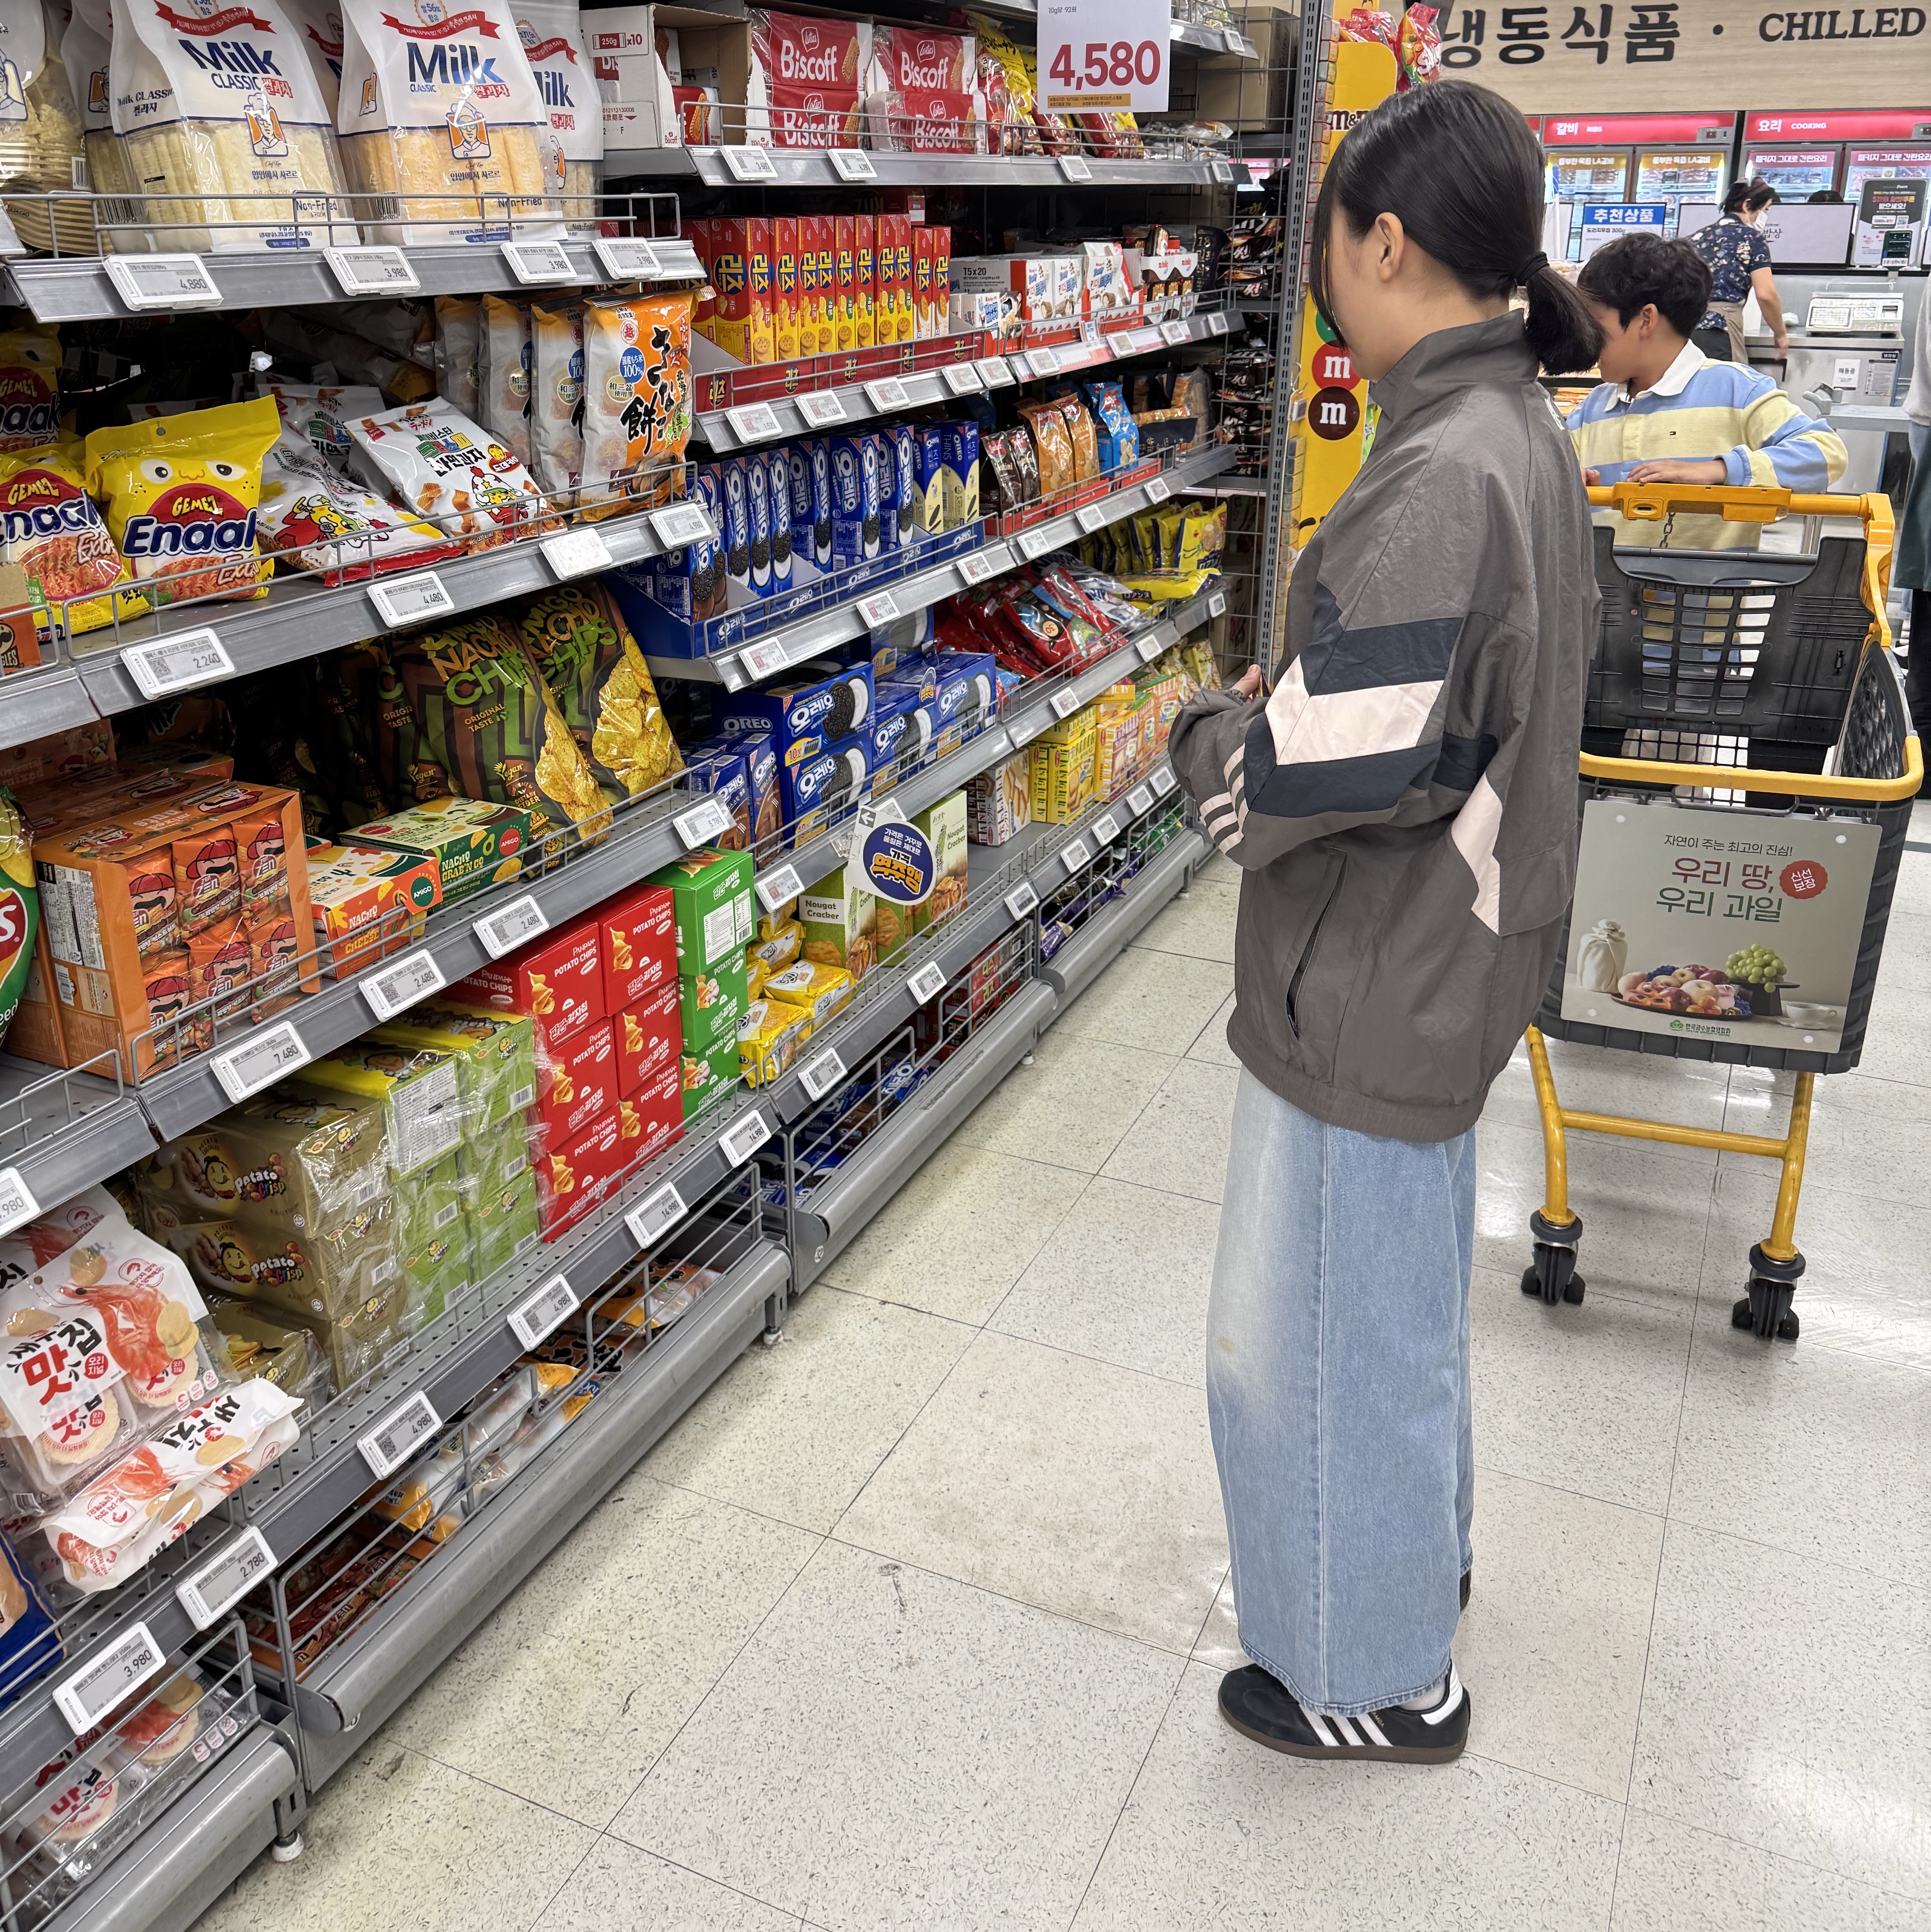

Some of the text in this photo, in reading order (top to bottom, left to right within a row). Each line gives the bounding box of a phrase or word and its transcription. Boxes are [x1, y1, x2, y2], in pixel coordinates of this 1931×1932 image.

[1758, 7, 1926, 42] CHILLED
[602, 33, 642, 46] 250g x10
[1442, 2, 1680, 69] 냉동식품
[178, 39, 282, 76] Milk
[407, 42, 506, 84] Milk
[781, 40, 838, 82] Biscoff
[1049, 40, 1161, 91] 4,580
[901, 51, 949, 90] Biscoff
[211, 73, 261, 91] CLASSIC
[410, 83, 510, 99] CLASSIC 쌀과자
[136, 87, 175, 102] CLASSIC
[133, 102, 158, 117] 쌀과자
[550, 113, 575, 130] 쌀과자
[783, 110, 840, 147] Biscoff
[1557, 123, 1578, 135] 갈비
[1758, 119, 1781, 133] 요리
[280, 170, 298, 179] 사르르
[482, 170, 501, 179] 사르르
[296, 200, 338, 211] Non-Fred
[1594, 209, 1654, 224] 추천상품
[384, 268, 408, 279] 3,980
[549, 260, 567, 270] 3,980
[180, 278, 207, 290] 4,880
[622, 356, 643, 366] 国産もち米
[1324, 356, 1350, 378] m
[623, 365, 644, 378] 100%
[559, 385, 580, 393] 和三盆
[609, 382, 633, 393] 和三盆
[1320, 402, 1347, 425] m
[913, 442, 922, 470] OREO
[943, 433, 952, 460] THINS
[953, 434, 961, 462] OREO
[814, 445, 831, 523] 오레오
[834, 447, 857, 512] 오레오
[864, 442, 881, 519] 오레오
[770, 454, 790, 537] 오레오
[171, 495, 223, 518] GEMEZ
[424, 592, 444, 603] 4,480
[193, 653, 220, 669] 2,240
[430, 629, 518, 682] NACHO
[388, 715, 413, 729] TASTE
[464, 702, 506, 727] ORIGINAL
[788, 693, 835, 737] 오레오
[468, 717, 495, 733] TASTE
[722, 717, 773, 732] OREO
[494, 762, 524, 781] Vegan
[797, 756, 837, 800] 오레오
[885, 827, 922, 849] 가격은 거꾸로
[946, 824, 965, 840] Nougat
[500, 836, 519, 848] AMIGO
[883, 835, 921, 856] 품질은 제대로
[947, 835, 966, 851] Cracker
[1664, 834, 1793, 857] 자연이 주는 최고의 진심!
[441, 851, 470, 871] NACHO
[890, 848, 911, 864] 가격
[442, 856, 484, 882] GRAB'N GO
[1671, 857, 1774, 894] 우리 땅,
[1790, 867, 1812, 883] 신선
[413, 885, 432, 899] AMIGO
[1793, 877, 1816, 892] 보장
[805, 899, 837, 910] Nougat
[807, 909, 839, 919] Cracker
[1656, 887, 1783, 923] 우리 과일
[349, 904, 378, 930] NACHO
[520, 914, 539, 930] 2,480
[345, 928, 380, 955] CHEESE
[580, 946, 597, 963] CHIPS
[714, 948, 743, 976] POTATO CHIPS
[414, 971, 435, 989] 2,480
[643, 987, 677, 1018] POTATO CHIPS
[573, 1033, 611, 1066] POTATO CHIPS
[706, 1029, 736, 1058] POTATO CHIPS
[273, 1045, 299, 1064] 7,480
[640, 1071, 678, 1104] POTATO CHIPS
[574, 1122, 617, 1157] POTATO CHIPS
[234, 1170, 278, 1194] Potato
[257, 1181, 286, 1199] Crisp
[661, 1200, 680, 1219] 14,980
[251, 1256, 295, 1279] Potato
[275, 1268, 303, 1285] Crisp
[553, 1294, 572, 1312] 4,980
[88, 1356, 105, 1366] 오리
[88, 1366, 104, 1375] 지널
[412, 1413, 432, 1435] 4,980
[240, 1551, 265, 1578] 2,780
[124, 1649, 153, 1678] 3,980
